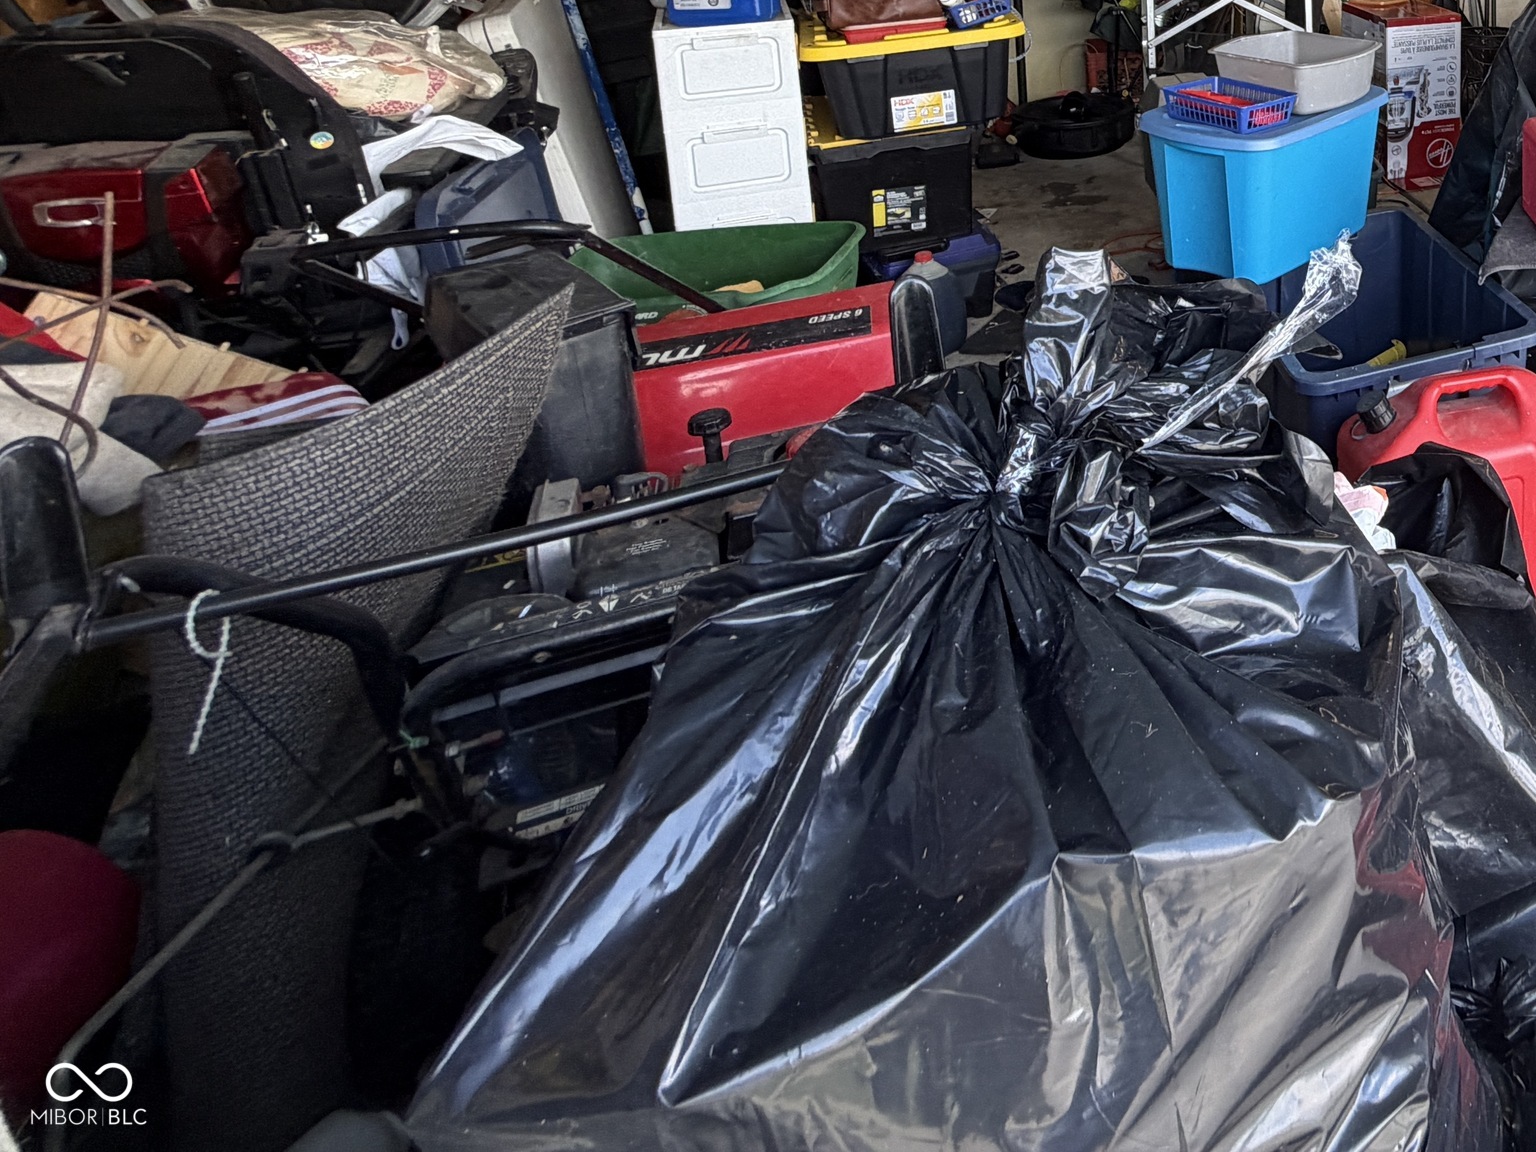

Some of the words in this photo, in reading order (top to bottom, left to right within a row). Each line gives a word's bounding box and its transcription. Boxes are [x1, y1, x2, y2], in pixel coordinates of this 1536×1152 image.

[893, 98, 915, 107] HDX
[808, 308, 852, 325] SPEED
[853, 307, 864, 318] 6
